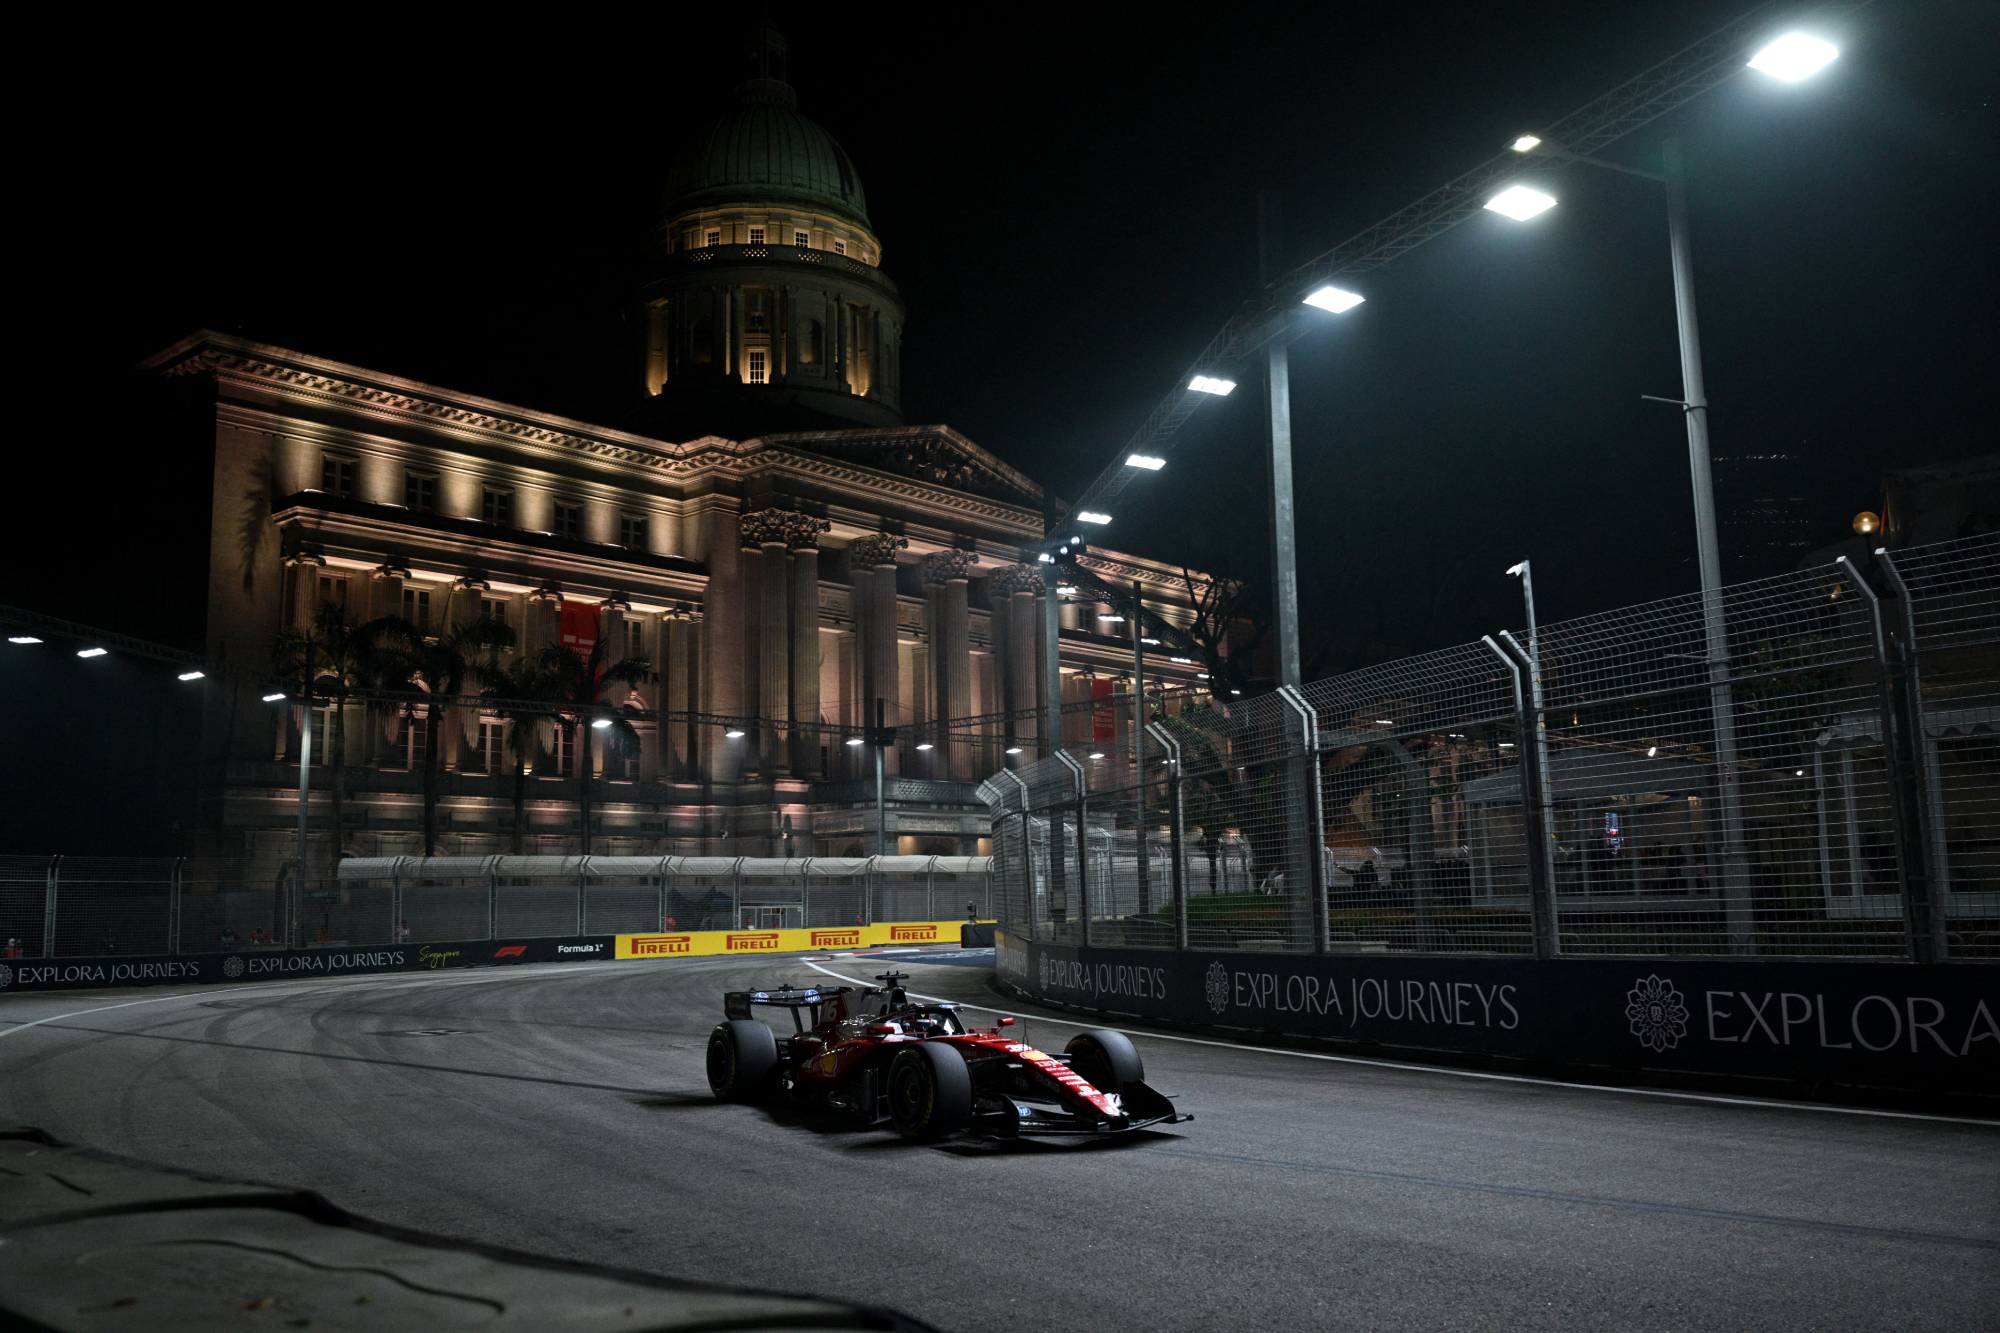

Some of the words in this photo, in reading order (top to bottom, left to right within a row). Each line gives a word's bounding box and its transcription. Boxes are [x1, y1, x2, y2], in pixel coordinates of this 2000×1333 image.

[726, 933, 779, 950] PIRELLI
[811, 930, 860, 947] PIRELLI
[889, 925, 937, 940] PIRELLI
[557, 945, 594, 953] Formula
[631, 936, 690, 954] PIRELLI
[18, 965, 105, 984] EXPLORA
[109, 961, 200, 983] JOURNEYS
[249, 957, 325, 974] EXPLORA
[327, 951, 405, 971] JOURNEYS
[1050, 959, 1093, 990] EXPLORA
[1094, 963, 1166, 1000] JOURNEYS
[1234, 971, 1343, 1016] EXPLORA
[1350, 977, 1519, 1030] JOURNEYS
[1705, 991, 2000, 1057] EXPLORA
